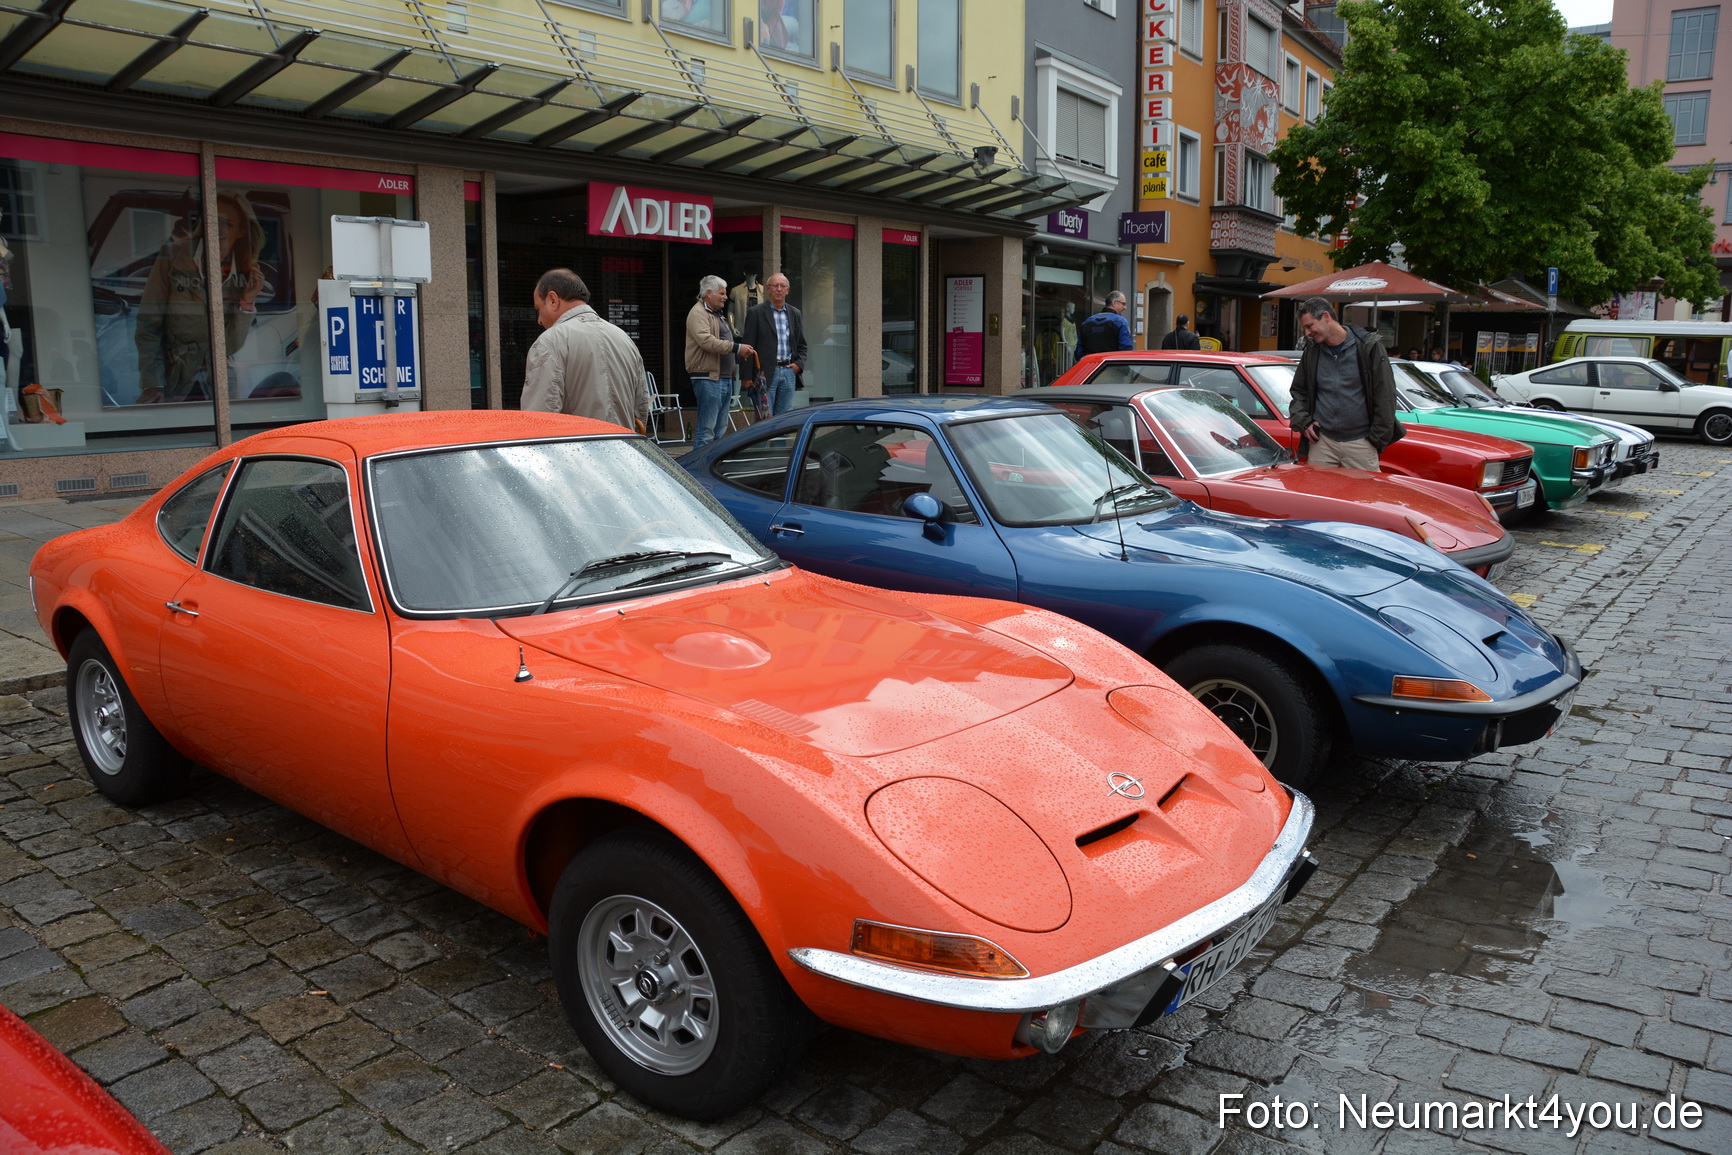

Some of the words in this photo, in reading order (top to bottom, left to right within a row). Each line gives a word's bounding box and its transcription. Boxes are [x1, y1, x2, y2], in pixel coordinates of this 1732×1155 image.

[1144, 153, 1167, 168] café
[377, 177, 410, 191] ADLER
[1143, 181, 1167, 196] plank
[600, 186, 713, 240] ADLER
[1058, 209, 1083, 233] liberty
[1123, 219, 1163, 236] liberty
[902, 234, 918, 242] ADLER
[1550, 271, 1556, 291] P
[363, 298, 406, 315] HIR
[331, 316, 345, 347] P
[330, 356, 350, 372] SCHEINE
[362, 366, 412, 385] SCHNE
[1181, 950, 1224, 1001] RH
[1225, 922, 1256, 970] GT
